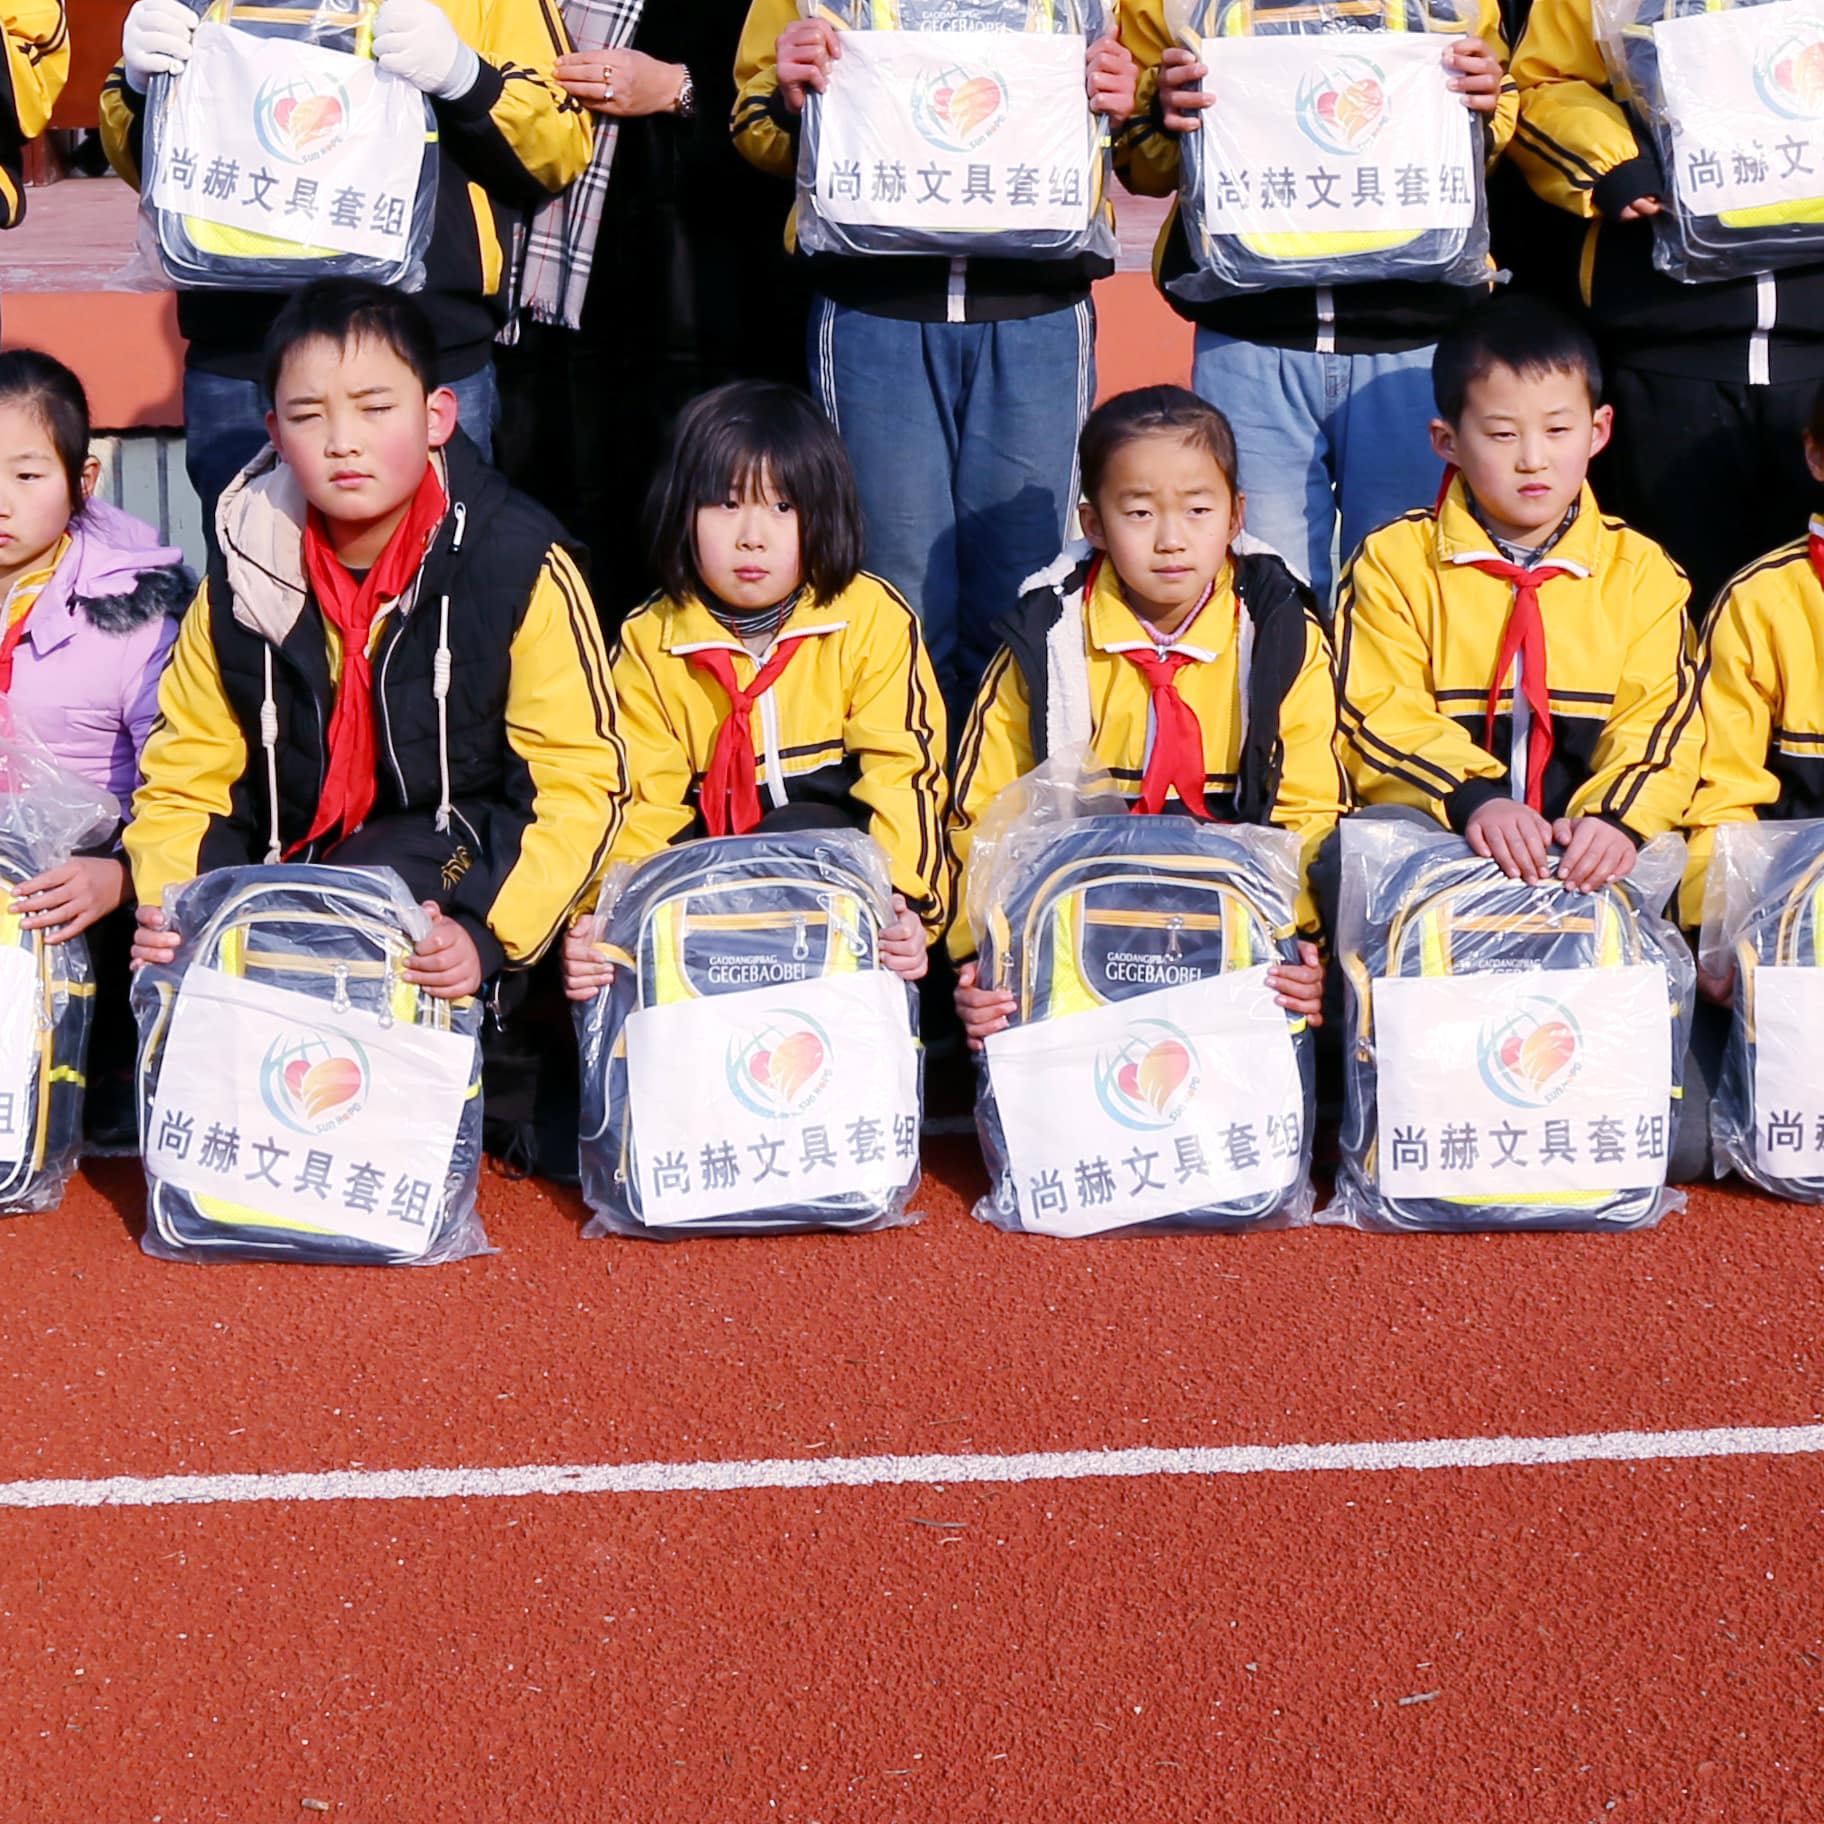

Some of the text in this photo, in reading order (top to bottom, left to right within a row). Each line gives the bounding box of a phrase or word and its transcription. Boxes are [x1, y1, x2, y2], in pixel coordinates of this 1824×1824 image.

[163, 150, 403, 235] 尚赫文具套组
[828, 160, 1084, 209] 尚赫文具套组
[1215, 163, 1472, 212] 尚赫文具套组
[709, 964, 806, 984] GEGEBAOBEI
[1106, 962, 1202, 984] GEGEBAOBEI
[157, 1111, 432, 1227] 尚赫文具套组
[652, 1114, 916, 1197] 尚赫文具套组
[1031, 1113, 1302, 1219] 尚赫文具套组
[1392, 1114, 1665, 1171] 尚赫文具套组
